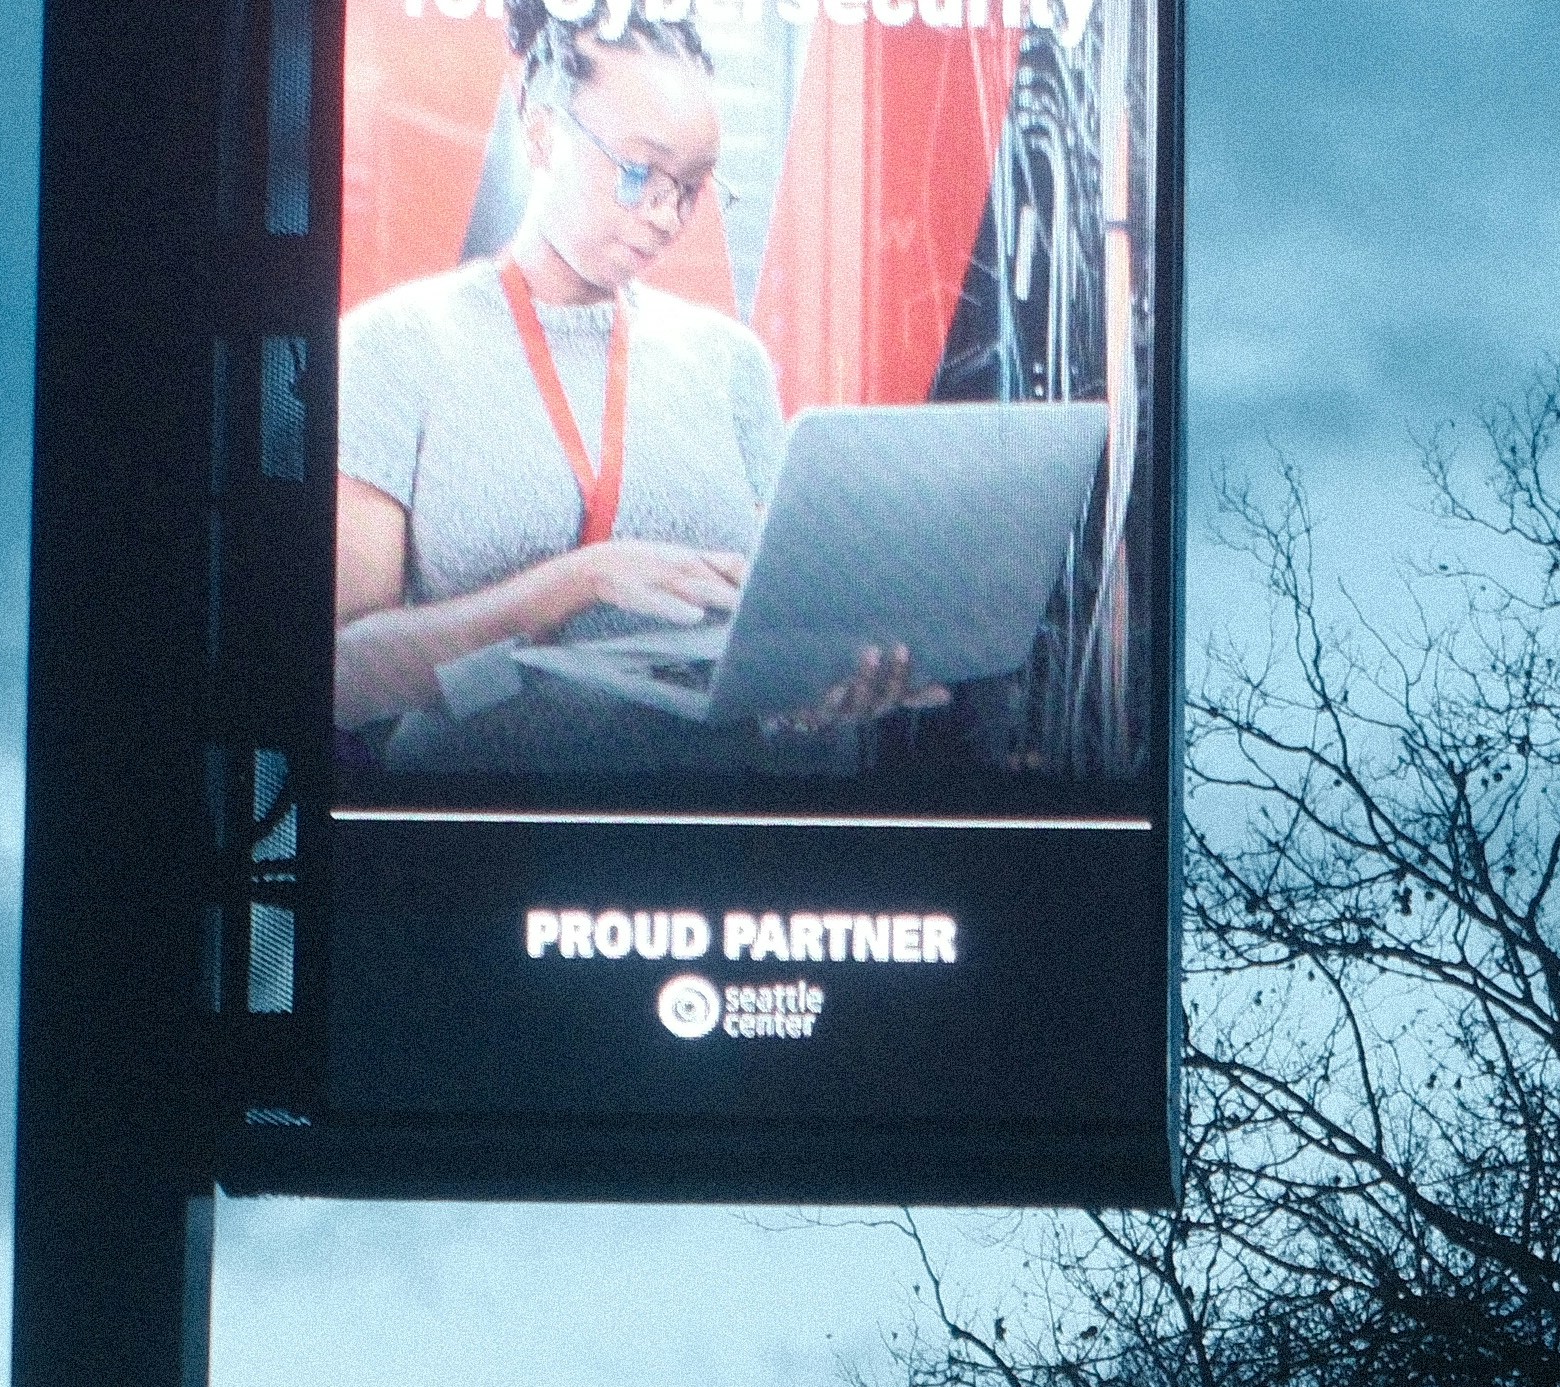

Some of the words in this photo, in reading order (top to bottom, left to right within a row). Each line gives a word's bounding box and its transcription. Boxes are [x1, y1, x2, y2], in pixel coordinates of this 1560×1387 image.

[526, 909, 710, 960] PROUD
[724, 912, 957, 963] PARTNER
[724, 980, 824, 1014] seattle
[723, 1012, 816, 1038] center
